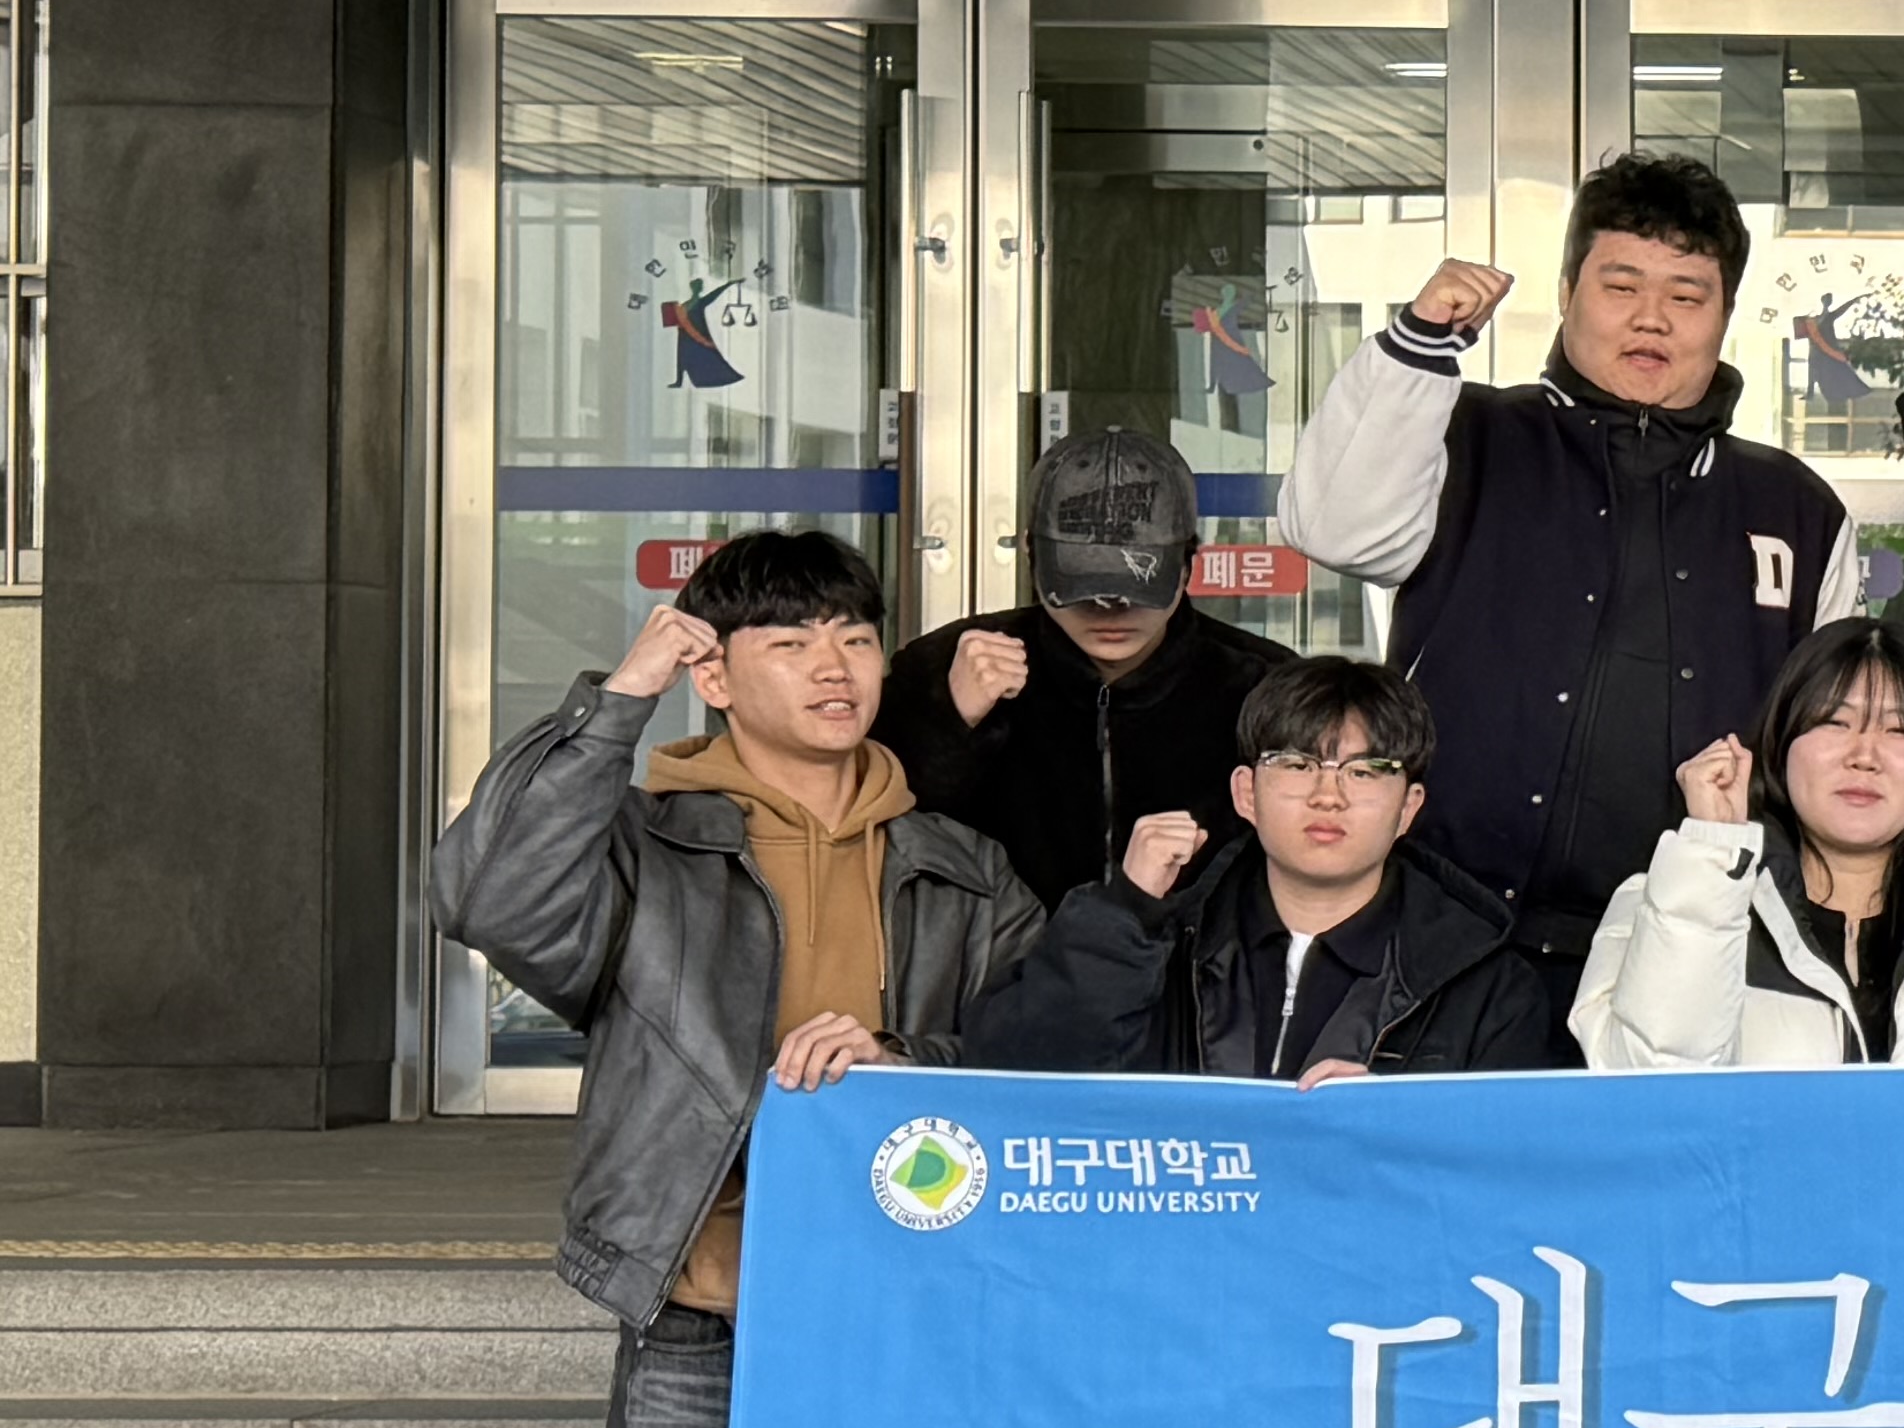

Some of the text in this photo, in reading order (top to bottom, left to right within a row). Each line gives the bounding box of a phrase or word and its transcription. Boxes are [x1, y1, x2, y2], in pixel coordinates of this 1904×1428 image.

[1202, 551, 1275, 589] 폐문
[1748, 534, 1795, 608] D
[1003, 1137, 1258, 1187] 대구대학교
[1000, 1191, 1260, 1213] DAEGU UNIVERSITY
